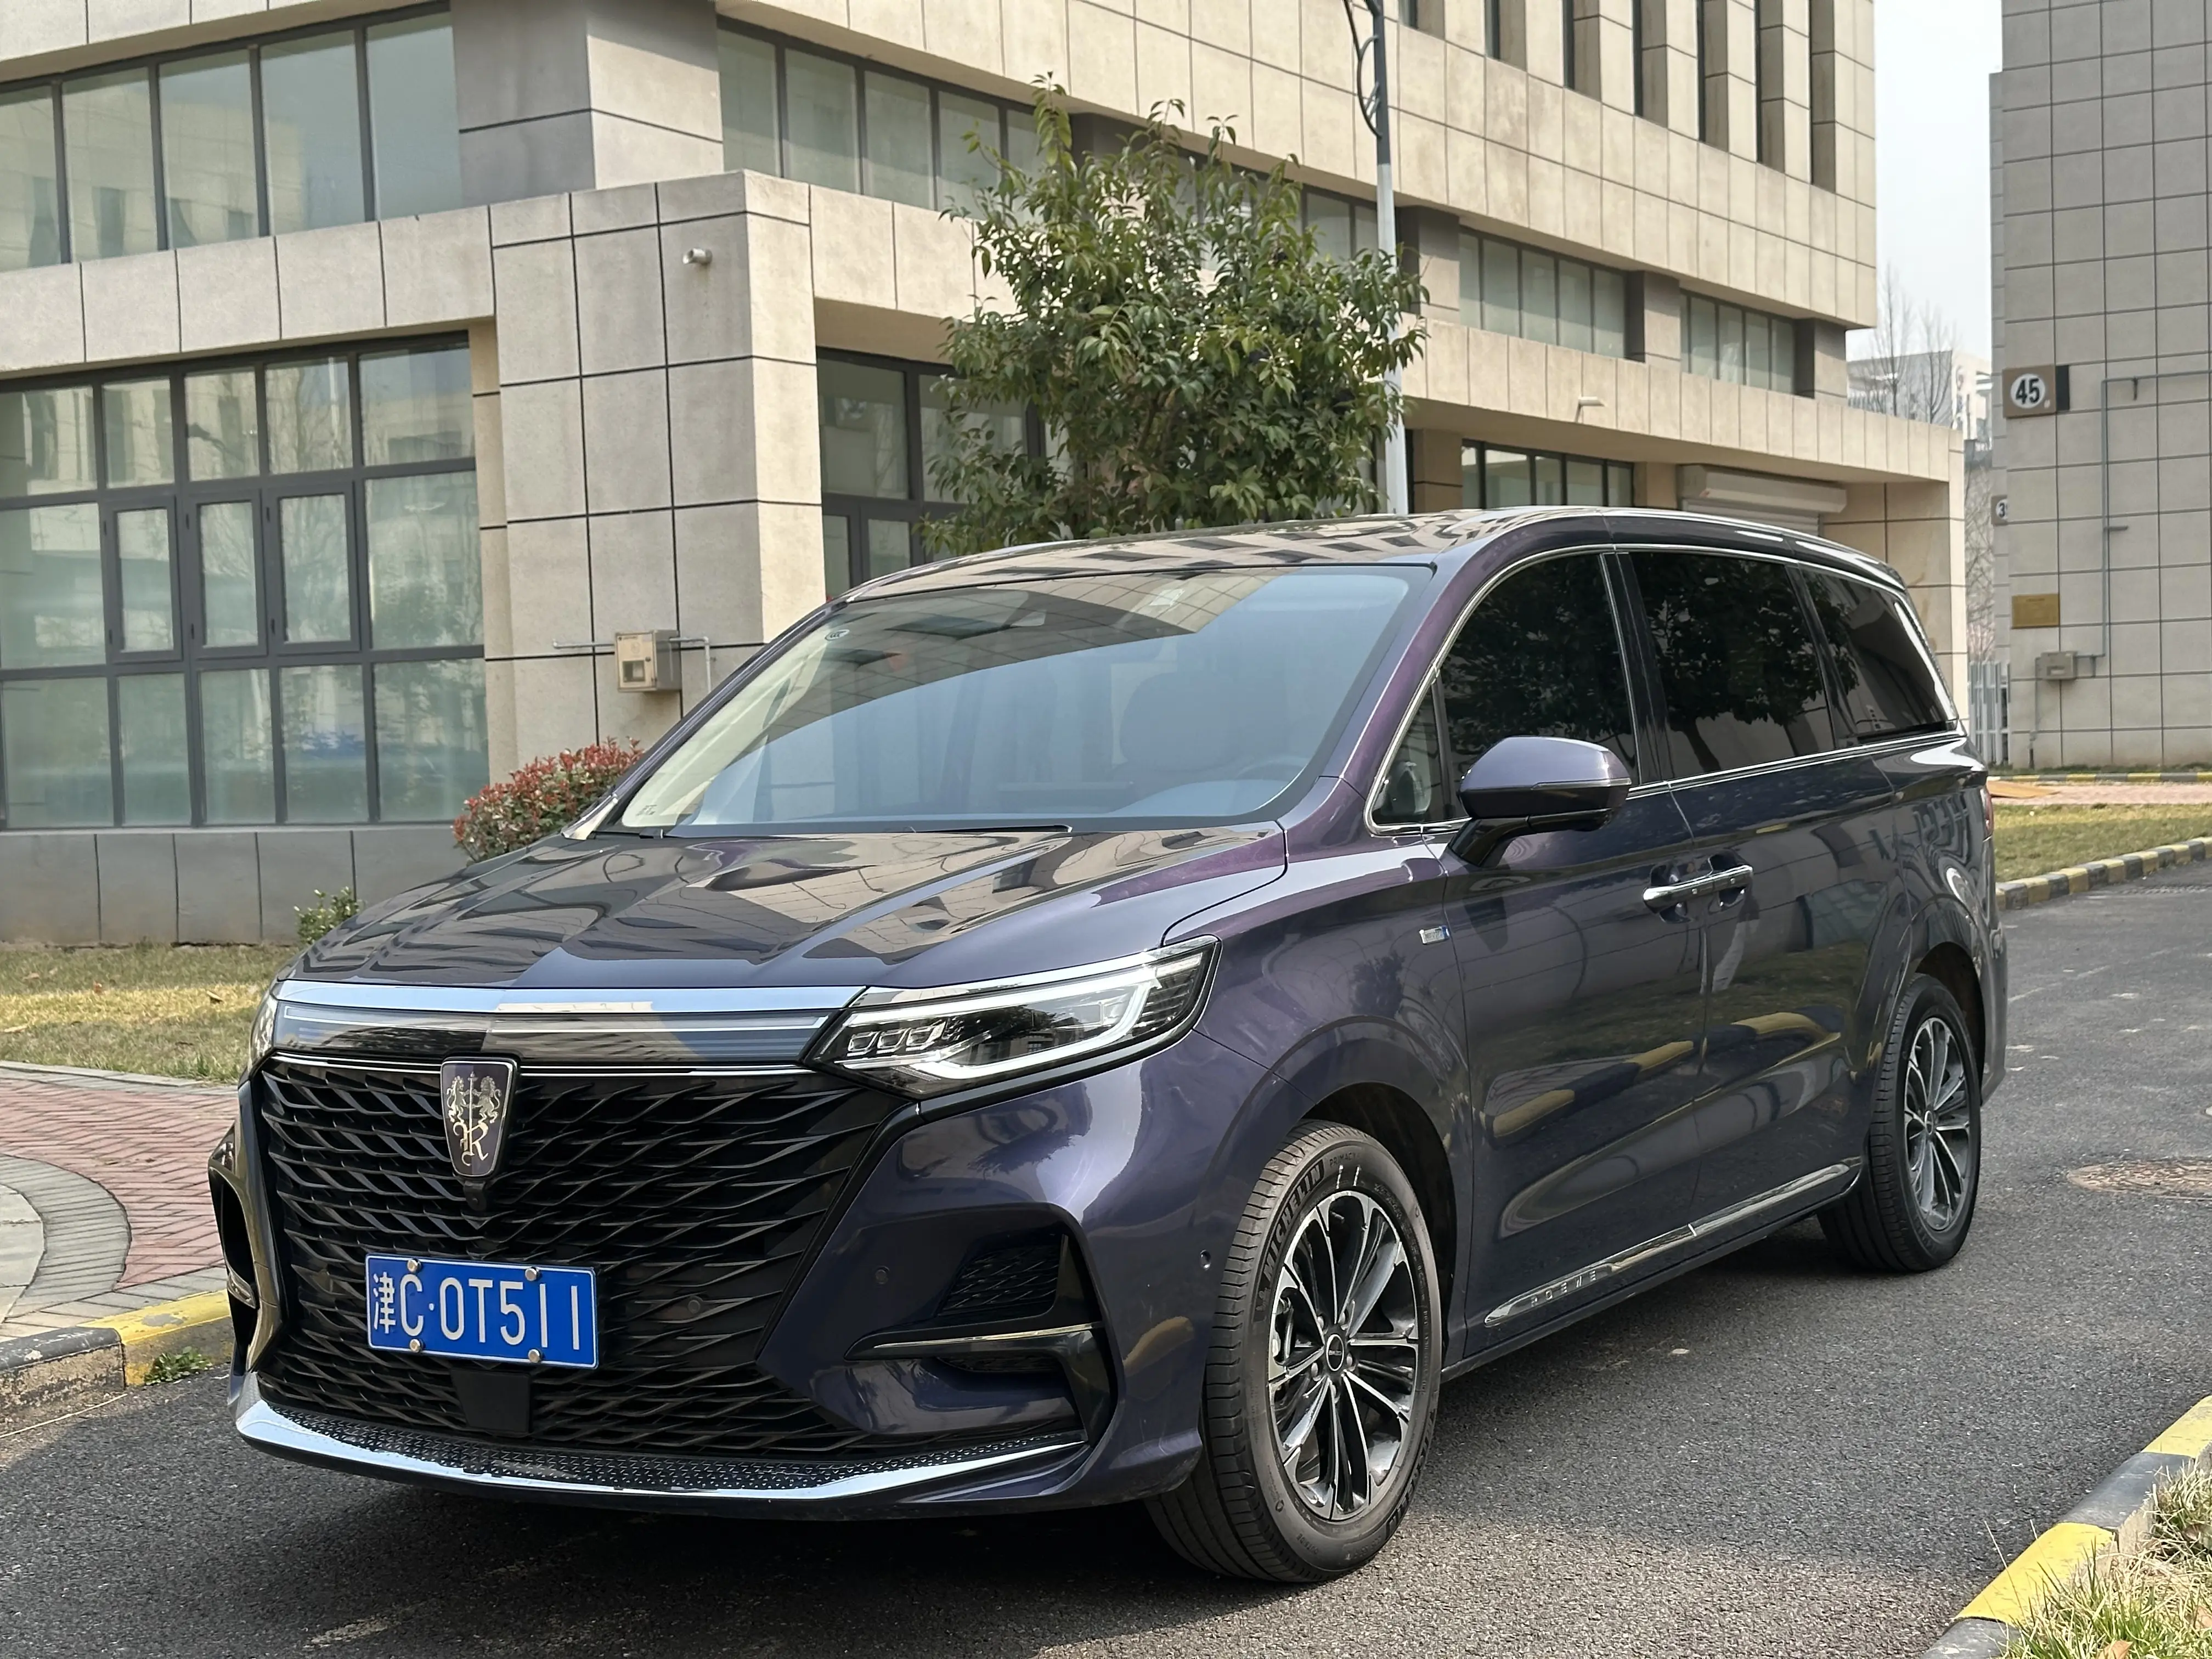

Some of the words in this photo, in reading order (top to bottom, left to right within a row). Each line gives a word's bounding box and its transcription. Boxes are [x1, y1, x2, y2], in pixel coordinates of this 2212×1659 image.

[2016, 378, 2040, 404] 45
[1999, 503, 2008, 518] 3
[1263, 1163, 1322, 1280] MICHELIN
